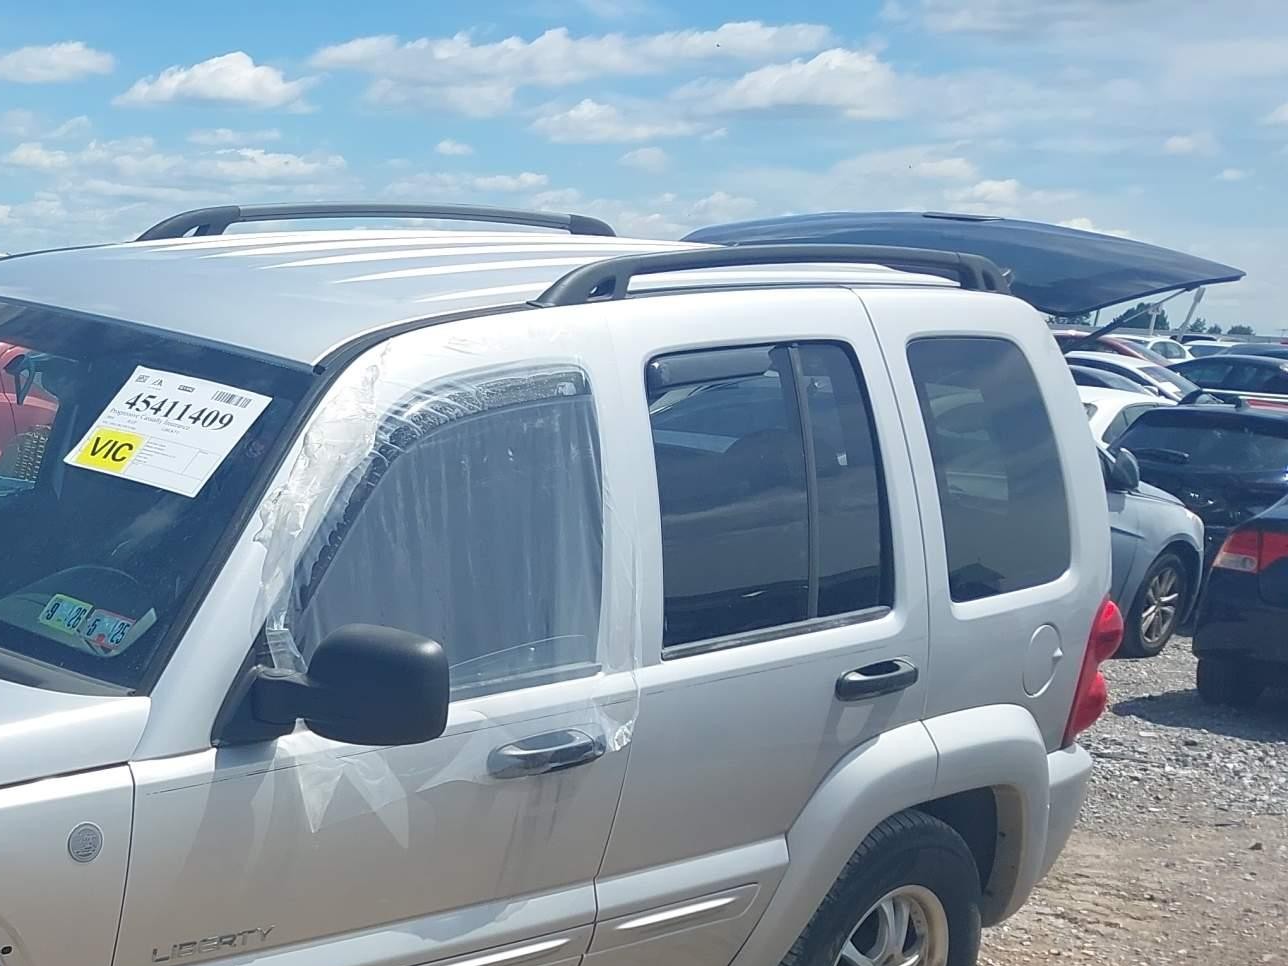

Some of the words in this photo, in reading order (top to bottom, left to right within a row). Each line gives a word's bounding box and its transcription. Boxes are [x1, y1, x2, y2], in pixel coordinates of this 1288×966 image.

[125, 392, 234, 431] 45411409
[89, 437, 134, 462] VIC
[152, 924, 276, 962] LIBERTY
